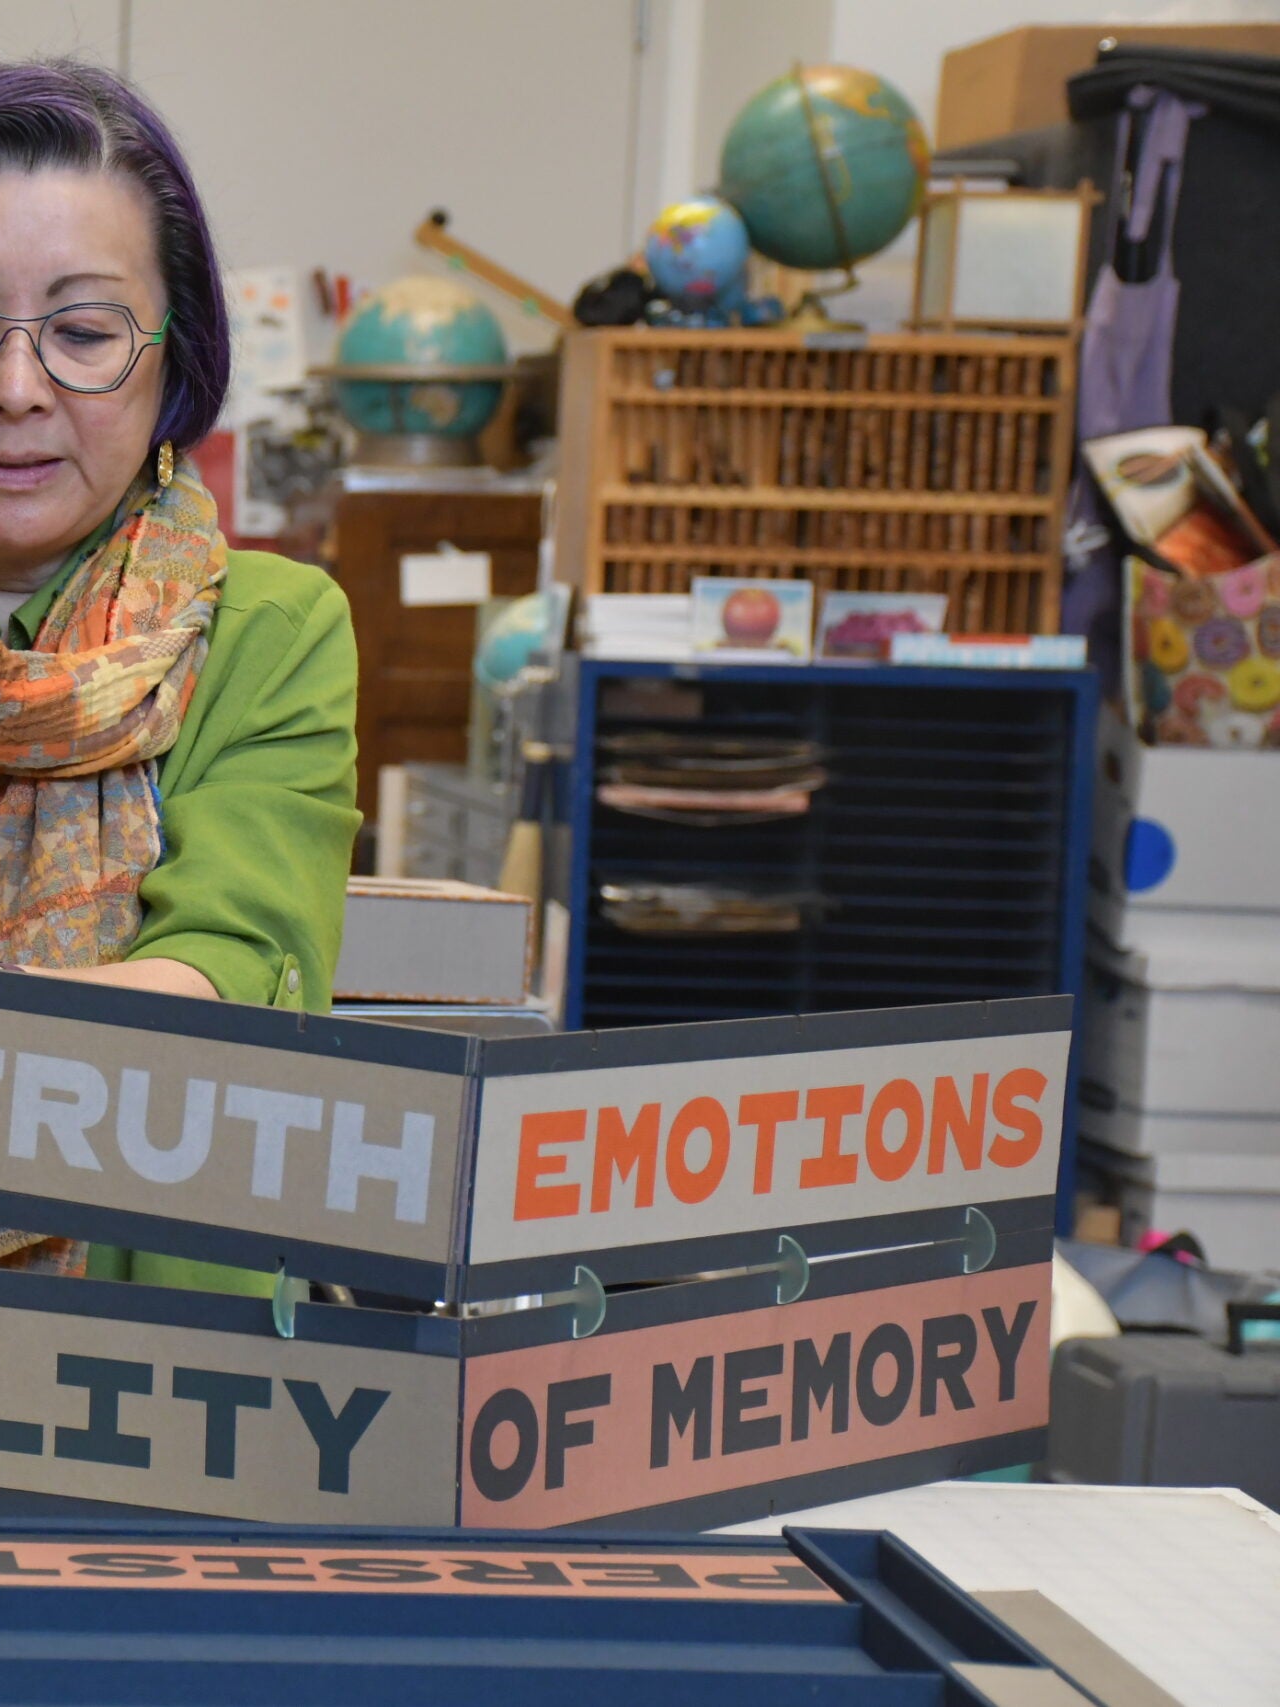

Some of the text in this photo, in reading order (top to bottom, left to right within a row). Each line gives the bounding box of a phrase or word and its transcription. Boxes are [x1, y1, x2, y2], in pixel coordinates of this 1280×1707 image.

[513, 1068, 1047, 1221] EMOTIONS
[471, 1374, 611, 1502] OF
[650, 1301, 1037, 1468] MEMORY
